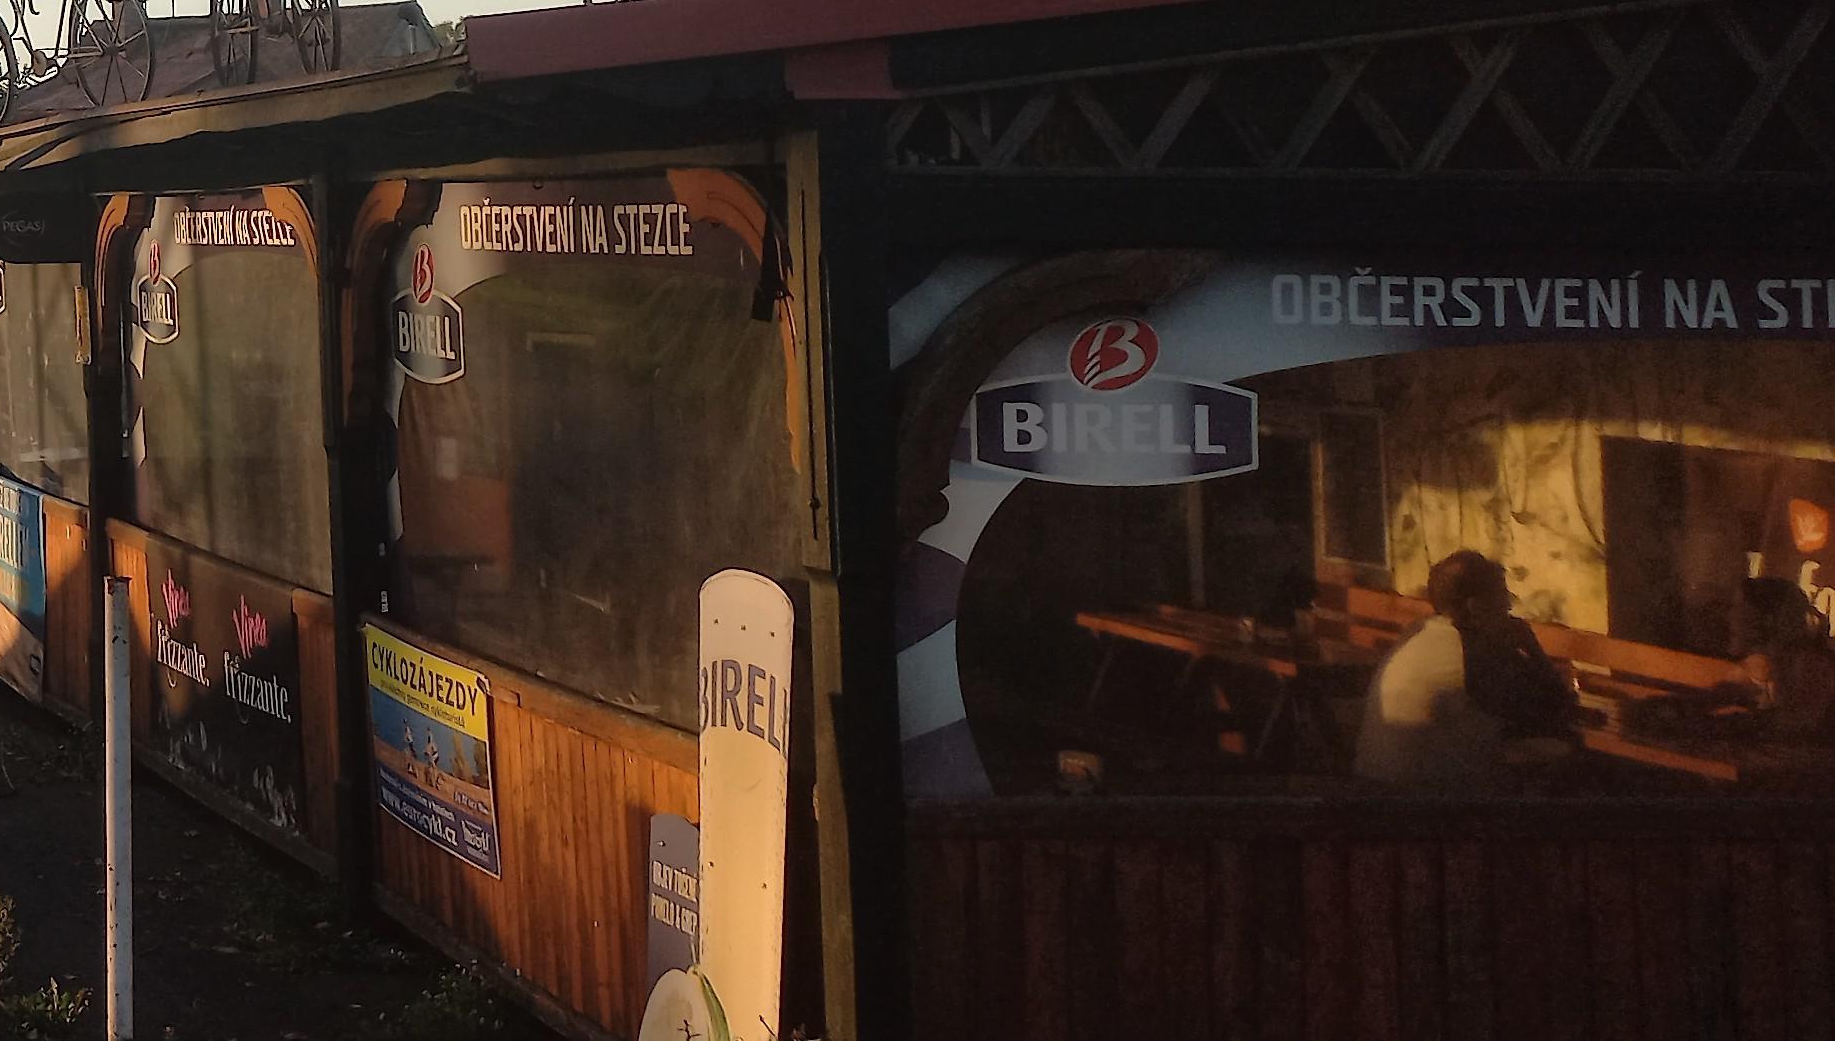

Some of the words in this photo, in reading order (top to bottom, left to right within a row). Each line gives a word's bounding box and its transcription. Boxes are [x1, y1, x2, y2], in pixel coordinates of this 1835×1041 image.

[235, 210, 250, 246] NA
[459, 197, 576, 254] OBČERSTVENÍ
[580, 204, 610, 255] NA
[613, 202, 694, 256] STEZCE
[141, 290, 174, 325] BIRELL
[1270, 266, 1643, 329] OBČERSTVENÍ
[1664, 278, 1739, 329] NA
[1757, 278, 1835, 329] ST
[397, 310, 457, 360] BIRELL
[1002, 401, 1228, 455] BIRELL
[371, 642, 477, 716] CYKLOZÁJEZDY
